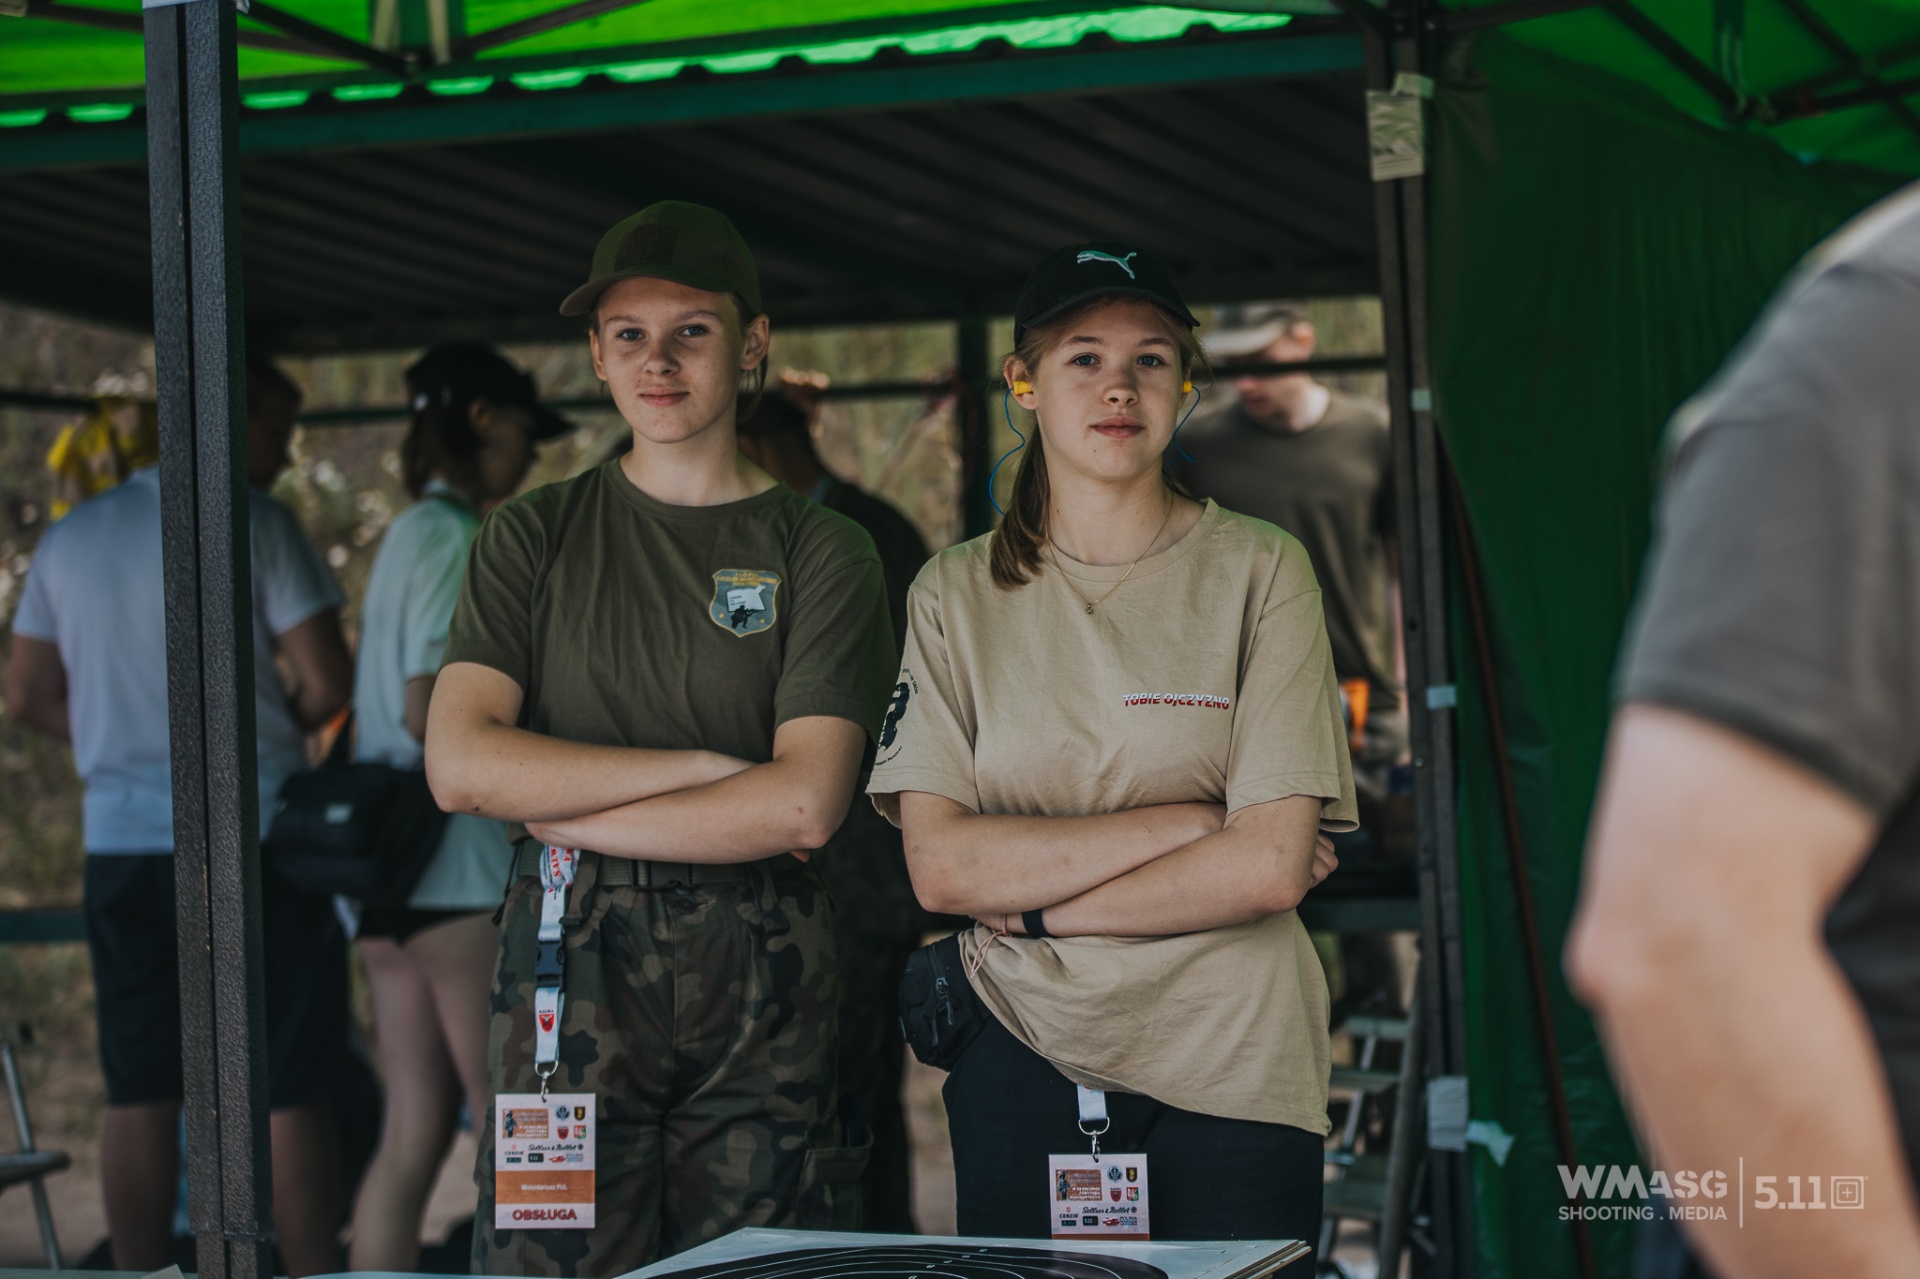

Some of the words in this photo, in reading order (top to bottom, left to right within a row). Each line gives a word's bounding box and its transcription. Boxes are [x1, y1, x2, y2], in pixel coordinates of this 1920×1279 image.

[1123, 693, 1160, 706] TOBIE
[1164, 693, 1229, 710] OJCZYZNO
[512, 1209, 577, 1221] OBSŁUGA
